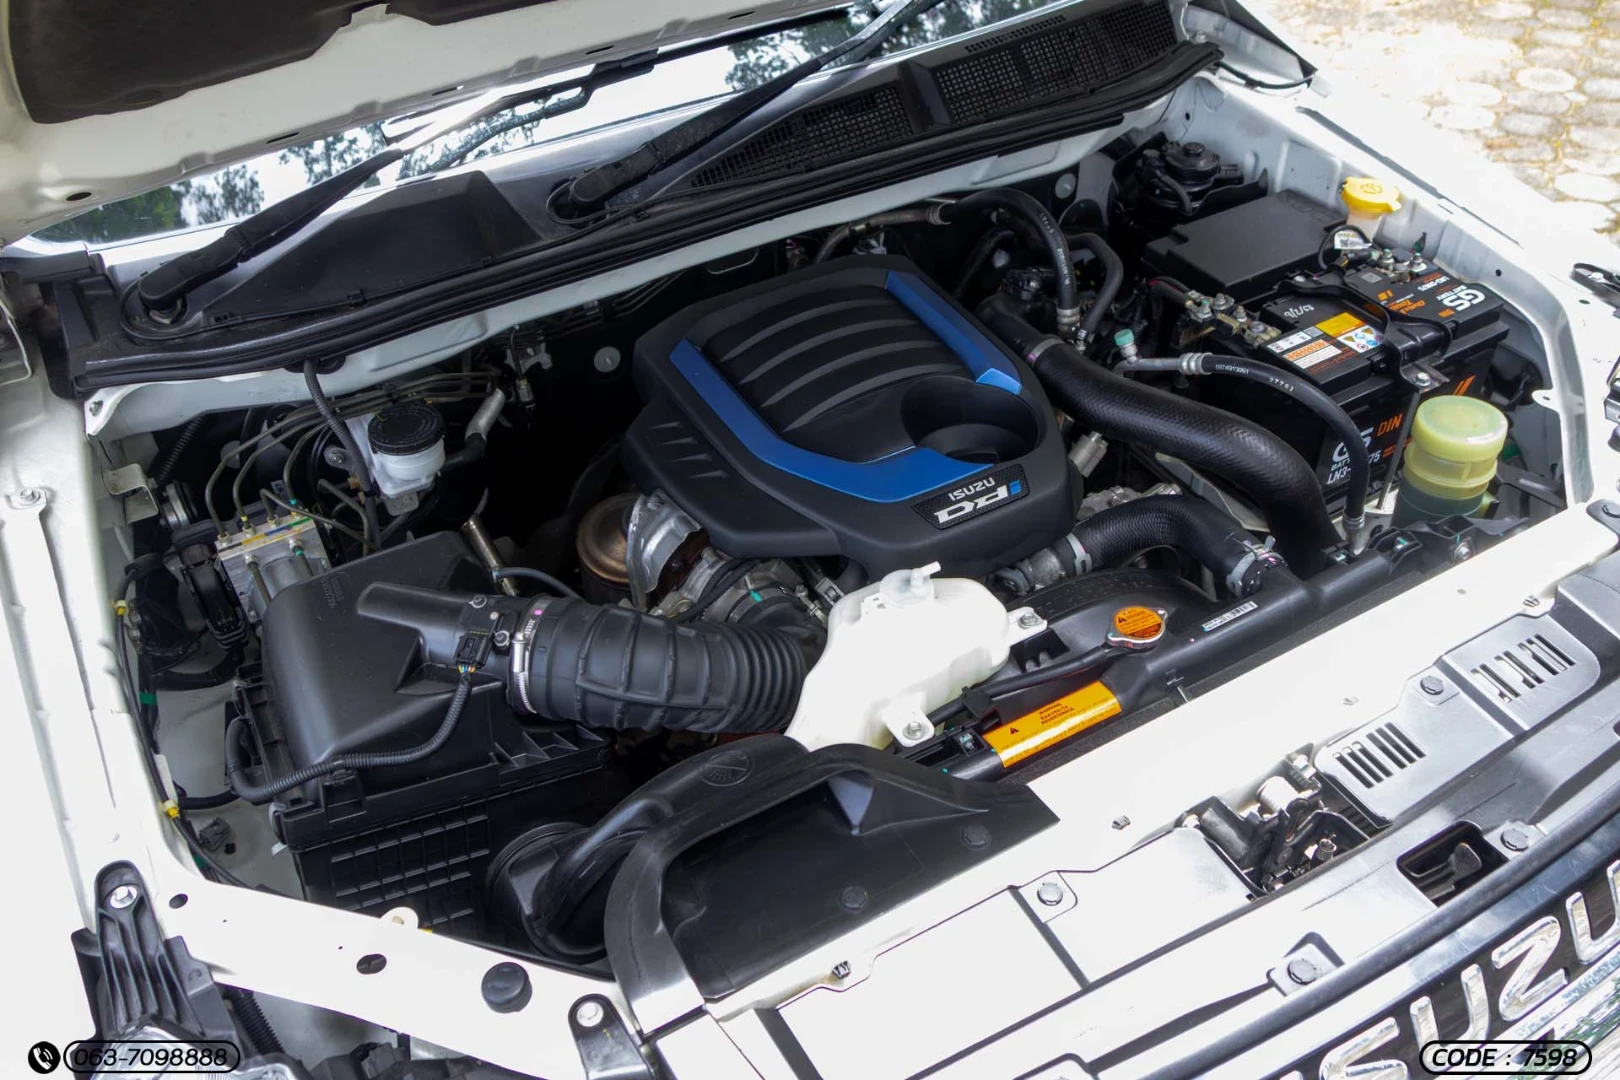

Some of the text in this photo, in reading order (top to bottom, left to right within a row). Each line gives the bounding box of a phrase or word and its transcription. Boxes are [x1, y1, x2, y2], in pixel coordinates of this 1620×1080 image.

[1442, 288, 1486, 311] GS
[1376, 413, 1404, 437] DIN
[948, 477, 996, 501] ISUZU
[1280, 859, 1620, 1080] SUZU
